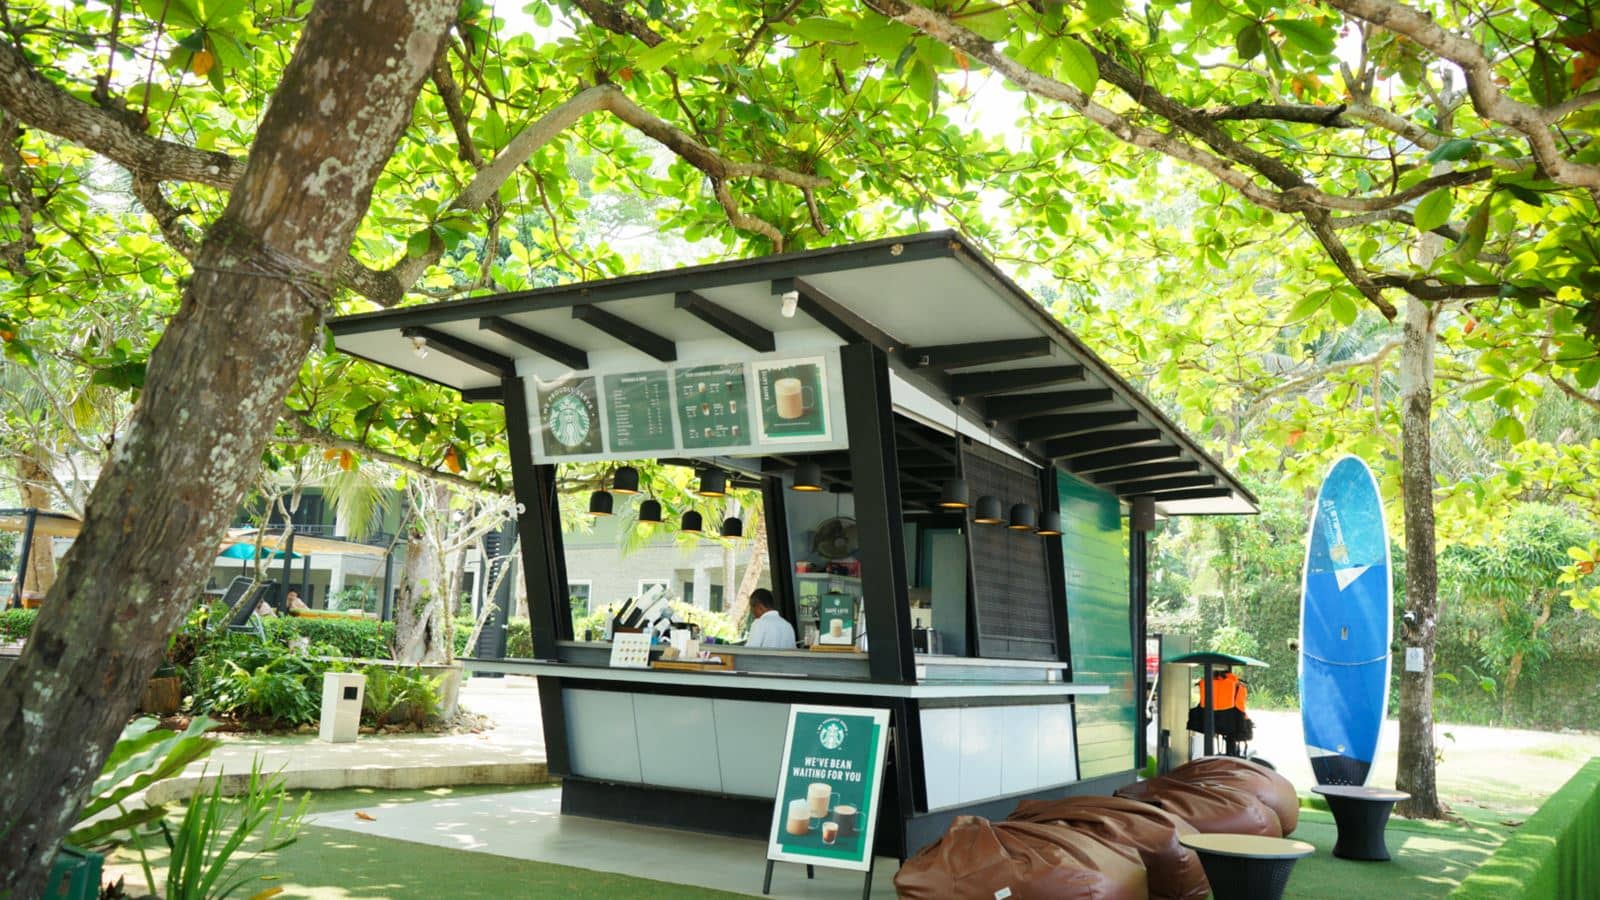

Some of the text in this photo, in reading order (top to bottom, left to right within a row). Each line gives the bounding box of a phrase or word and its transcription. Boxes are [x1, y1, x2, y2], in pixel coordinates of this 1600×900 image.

[804, 757, 852, 770] WE'VE BEAN
[793, 768, 862, 782] WAITING FOR YOU
